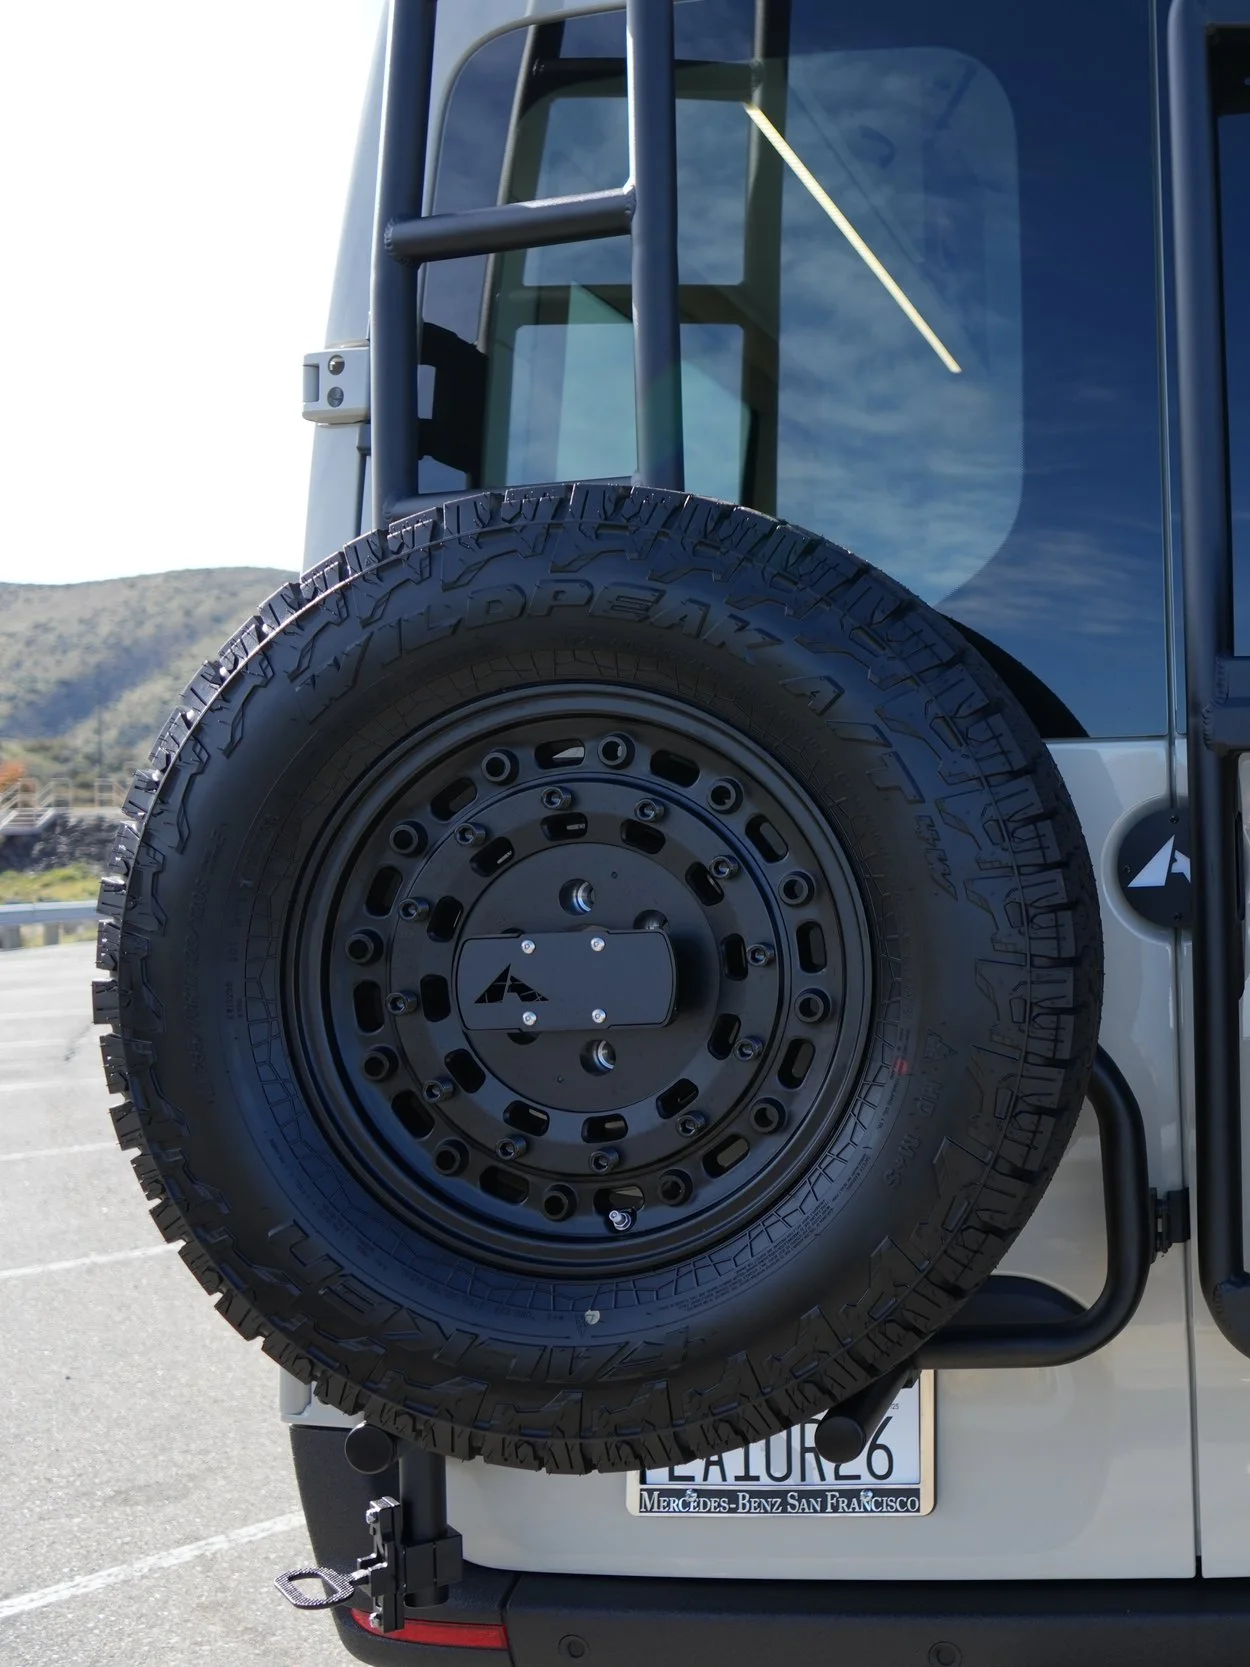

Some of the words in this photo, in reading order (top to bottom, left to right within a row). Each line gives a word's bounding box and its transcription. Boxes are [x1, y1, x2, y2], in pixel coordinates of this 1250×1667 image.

[296, 578, 786, 724] WILDPEAK
[640, 1491, 782, 1513] MERCEDES-BENZ
[786, 1491, 822, 1513] SAN
[825, 1491, 920, 1513] FRANCISCO
